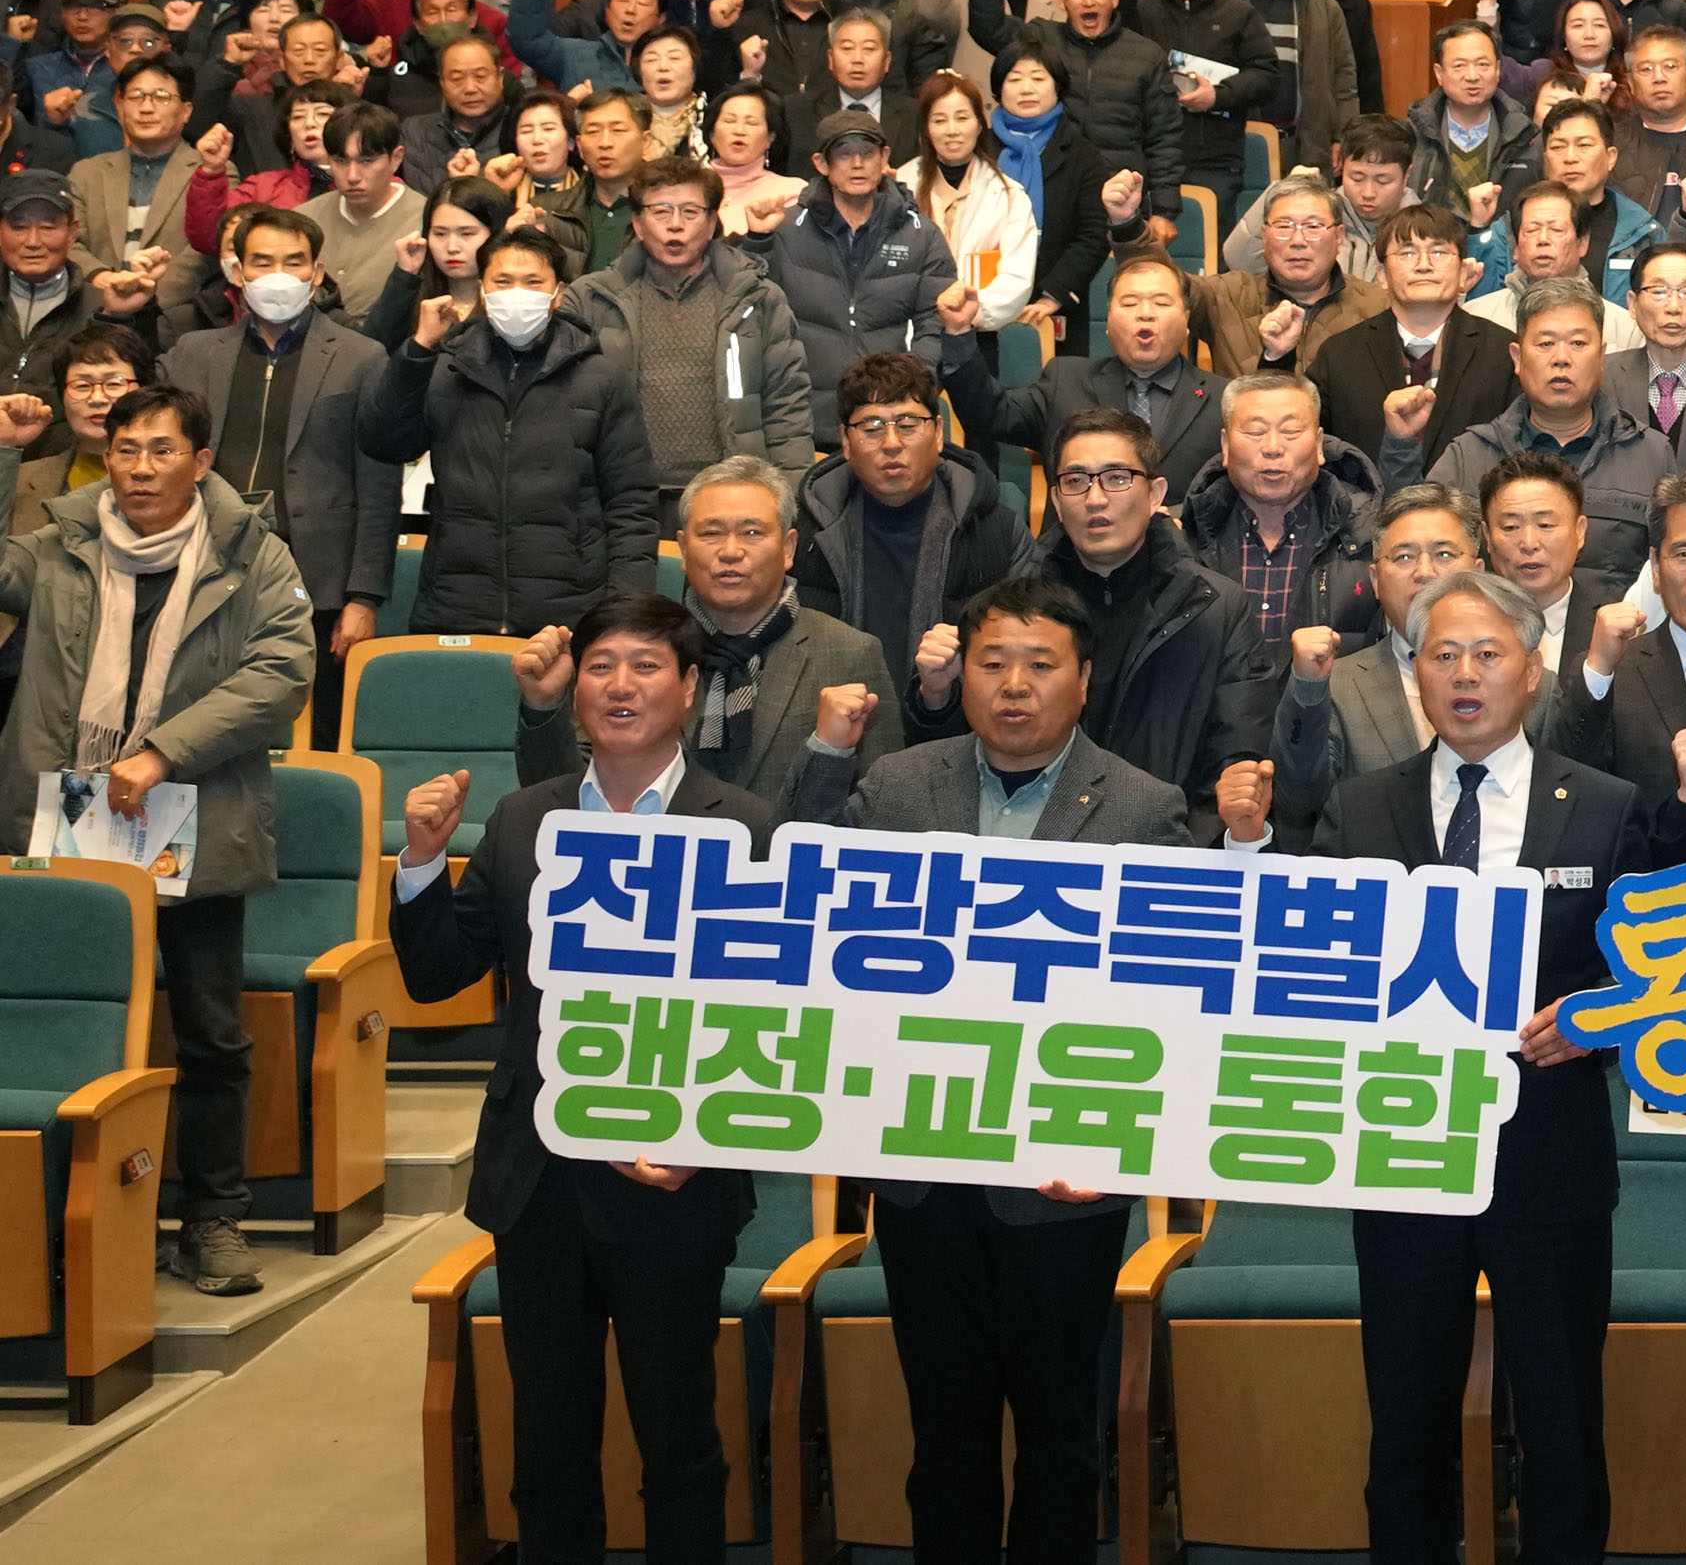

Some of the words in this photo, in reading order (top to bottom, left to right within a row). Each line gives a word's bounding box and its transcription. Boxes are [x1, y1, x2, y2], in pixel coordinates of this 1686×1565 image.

[546, 829, 1529, 1033] 전남광주특별시
[553, 990, 1165, 1176] 행정·교육
[1207, 1034, 1499, 1195] 통합
